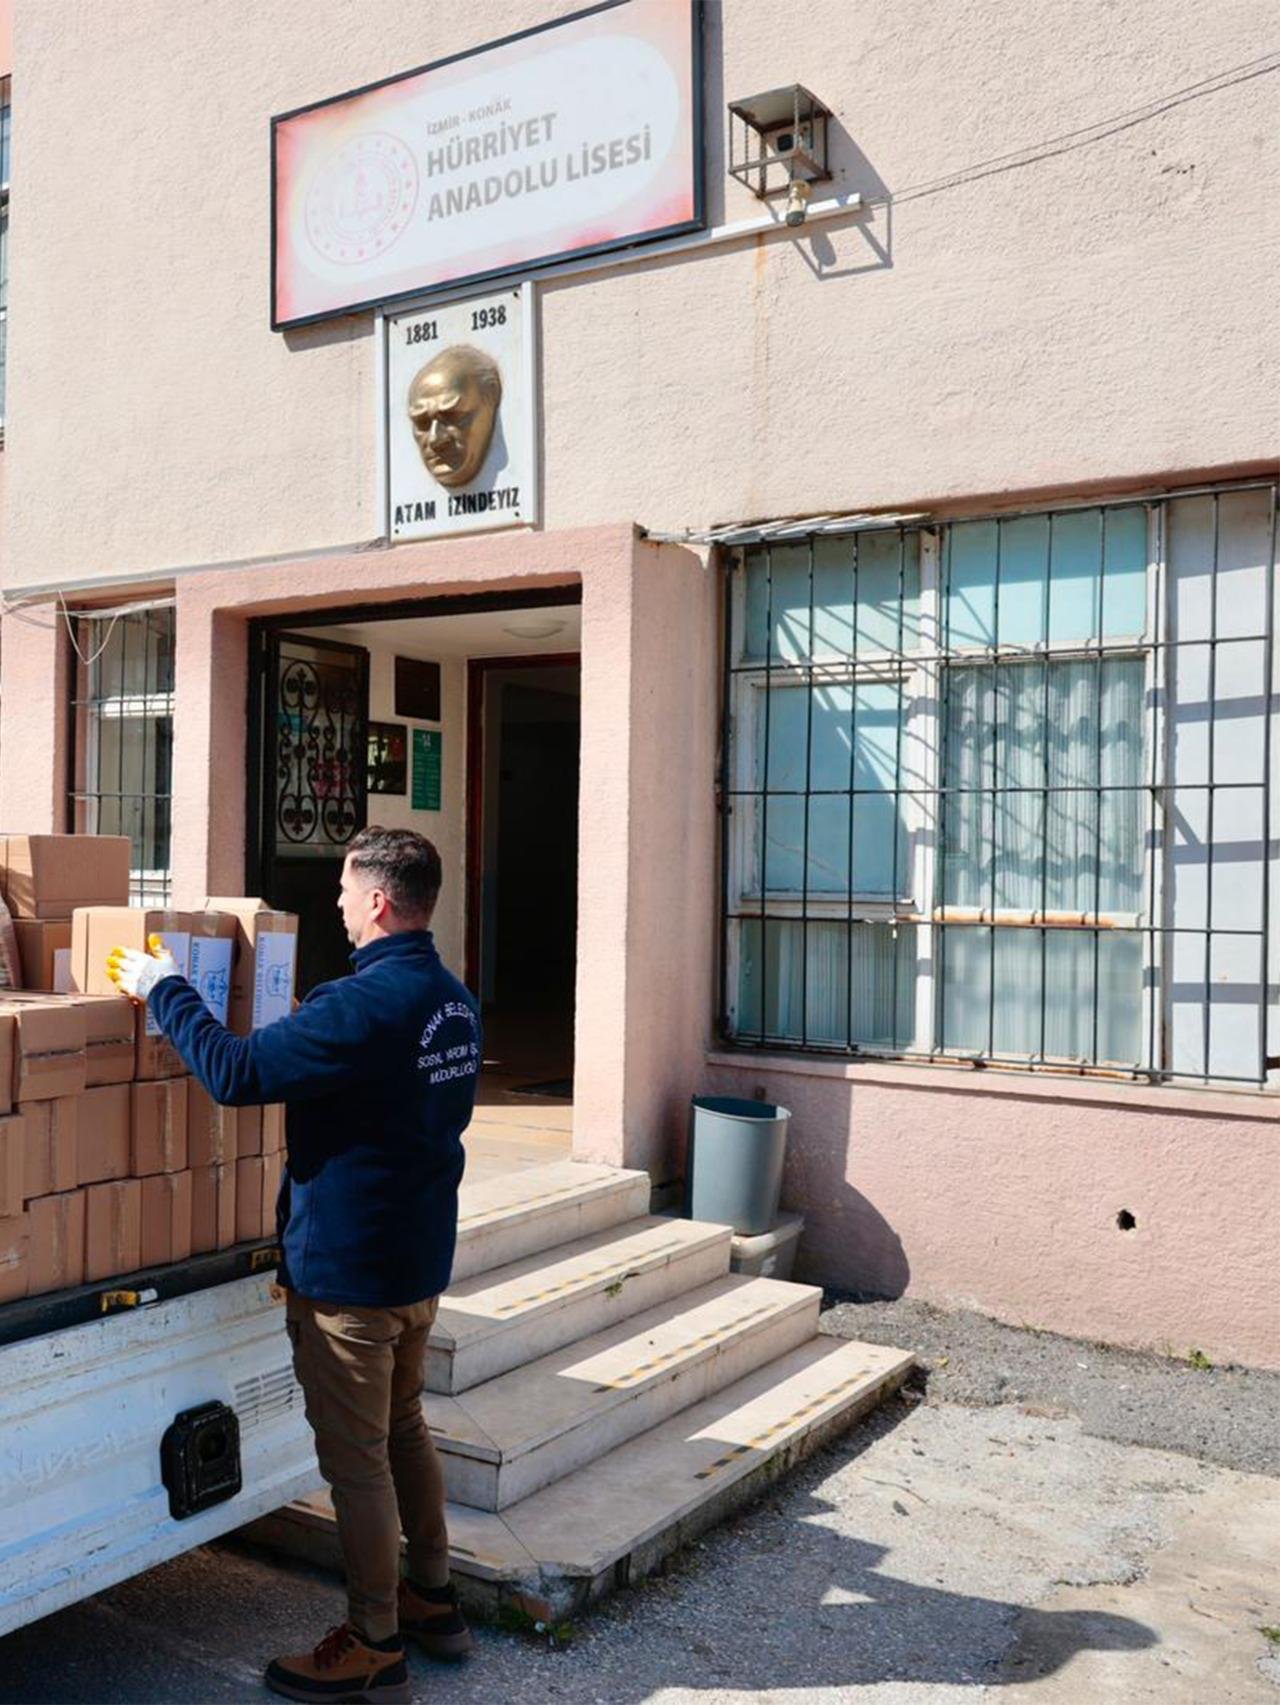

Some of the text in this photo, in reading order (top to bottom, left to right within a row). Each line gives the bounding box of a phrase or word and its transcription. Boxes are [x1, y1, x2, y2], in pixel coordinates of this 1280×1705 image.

[426, 115, 460, 135] İZMİR
[468, 98, 511, 122] KONAK
[427, 113, 557, 177] HÜRRİYET
[427, 124, 652, 221] ANADOLU LİSESİ
[406, 321, 438, 345] 1881
[471, 305, 507, 330] 1938
[394, 501, 436, 525] ATAM
[419, 1009, 444, 1049] KONAK
